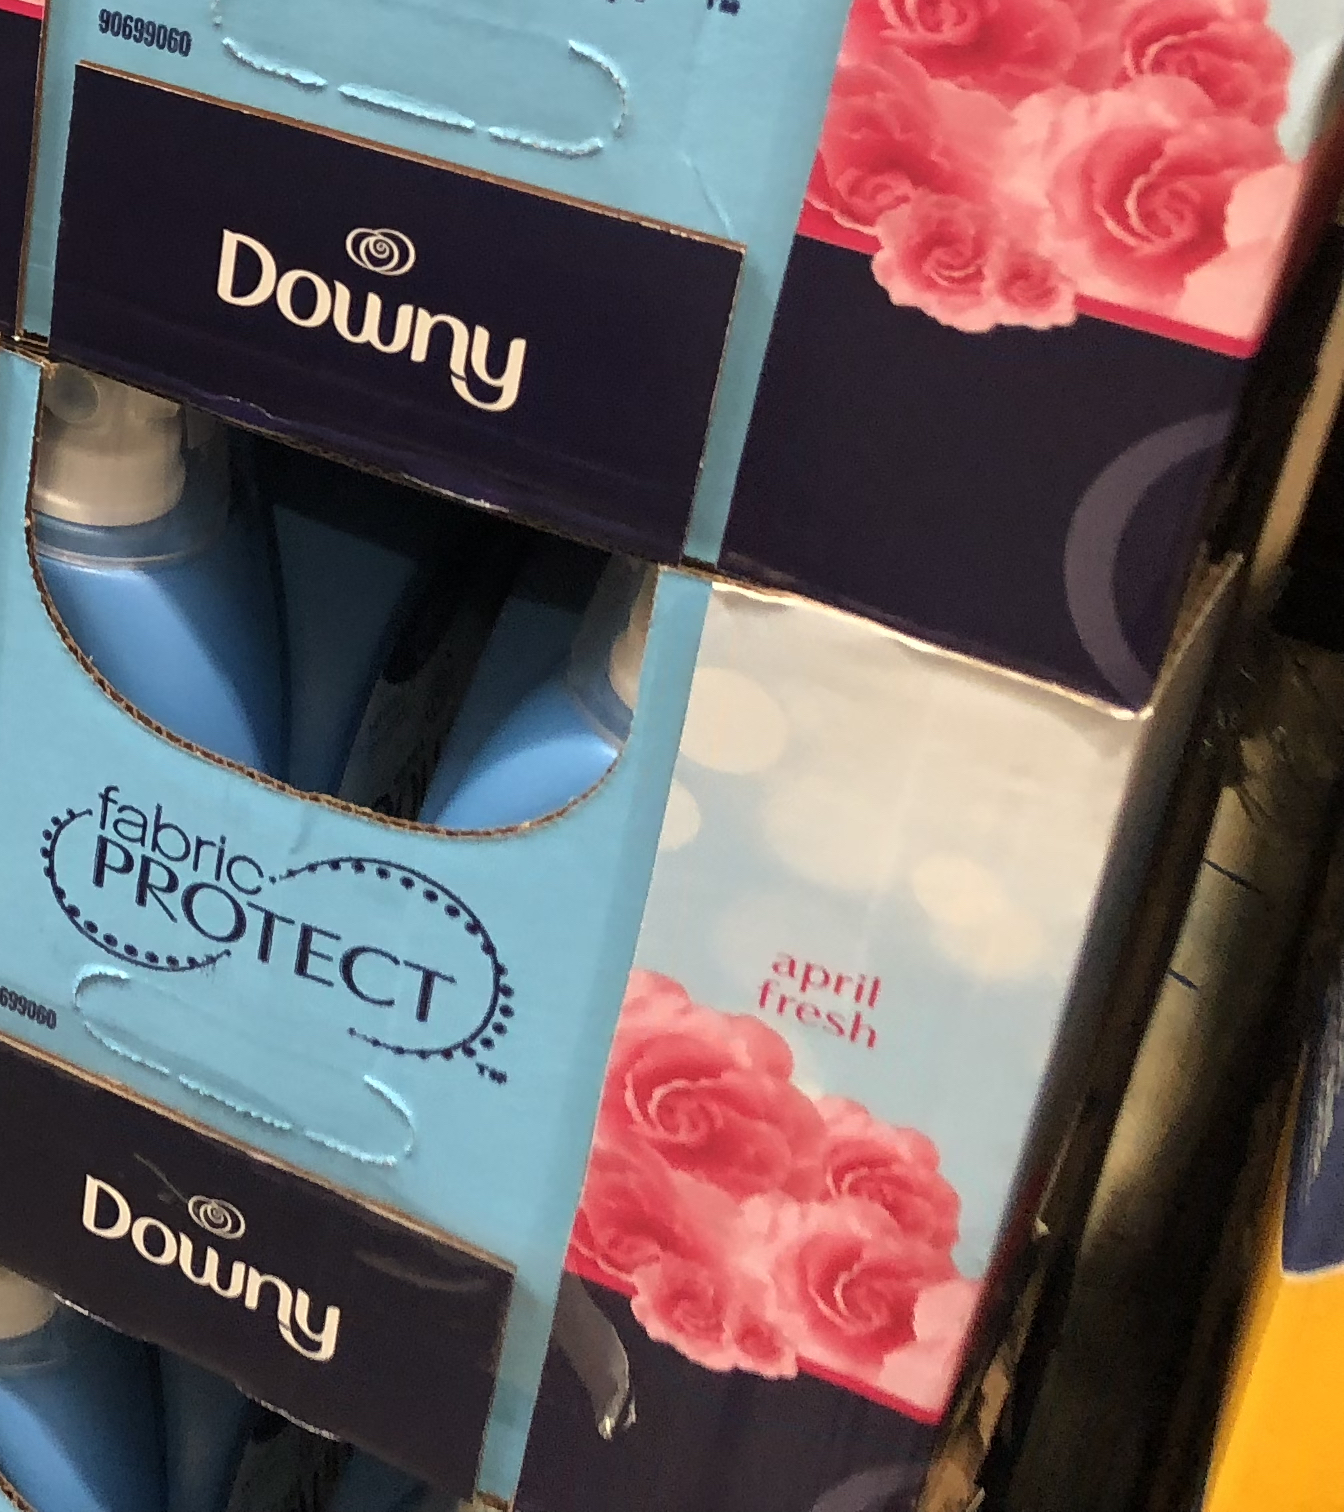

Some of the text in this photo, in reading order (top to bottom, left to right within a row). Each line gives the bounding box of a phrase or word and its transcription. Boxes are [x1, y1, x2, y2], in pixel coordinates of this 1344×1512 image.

[97, 7, 193, 58] 90699060
[214, 228, 528, 414] Downy
[96, 784, 266, 899] fabric
[90, 833, 458, 1025] PROTECT
[768, 950, 884, 1012] april
[756, 979, 879, 1050] fresh
[82, 1172, 342, 1364] Downy
